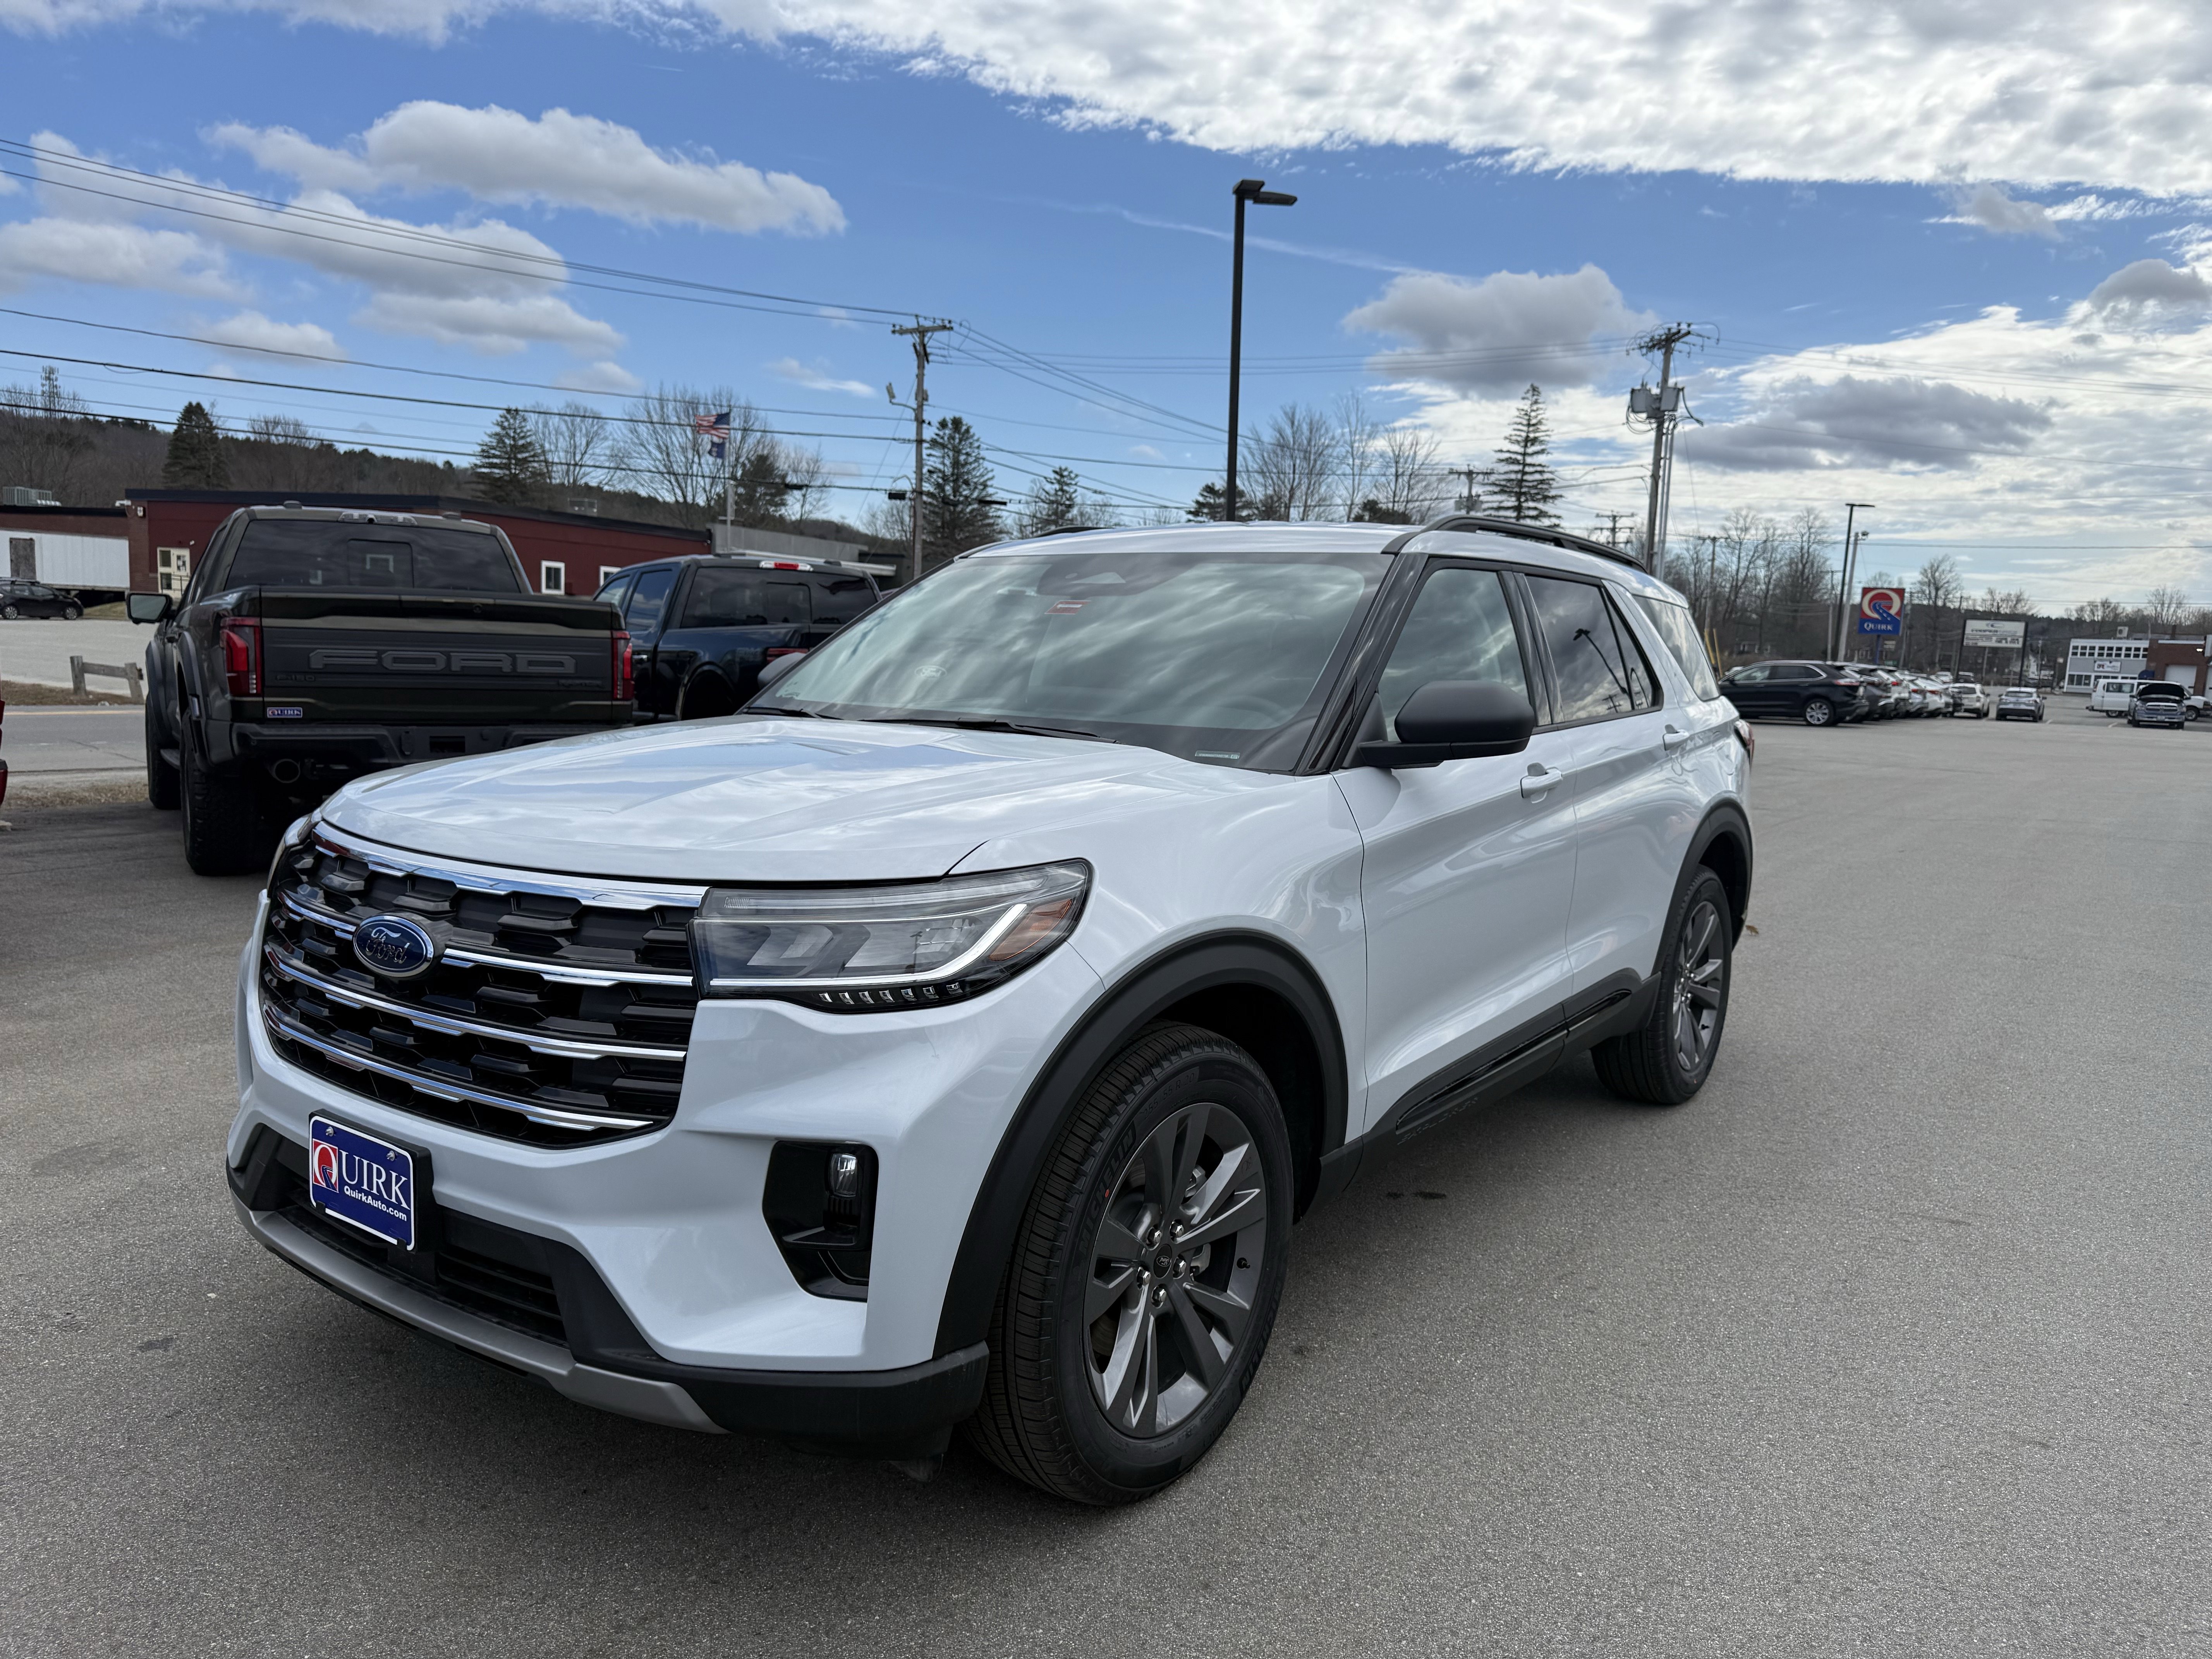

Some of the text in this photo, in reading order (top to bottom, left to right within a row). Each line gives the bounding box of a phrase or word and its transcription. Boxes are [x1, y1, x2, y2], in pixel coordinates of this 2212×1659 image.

[1864, 622, 1893, 631] QUIRK
[309, 649, 577, 673] FORD
[366, 927, 410, 964] Ford
[313, 1144, 410, 1210] QUIRK
[1079, 1129, 1133, 1255] MICHELIN
[344, 1185, 407, 1221] QuirkAuto.com
[1242, 1280, 1283, 1391] MICHELIN
